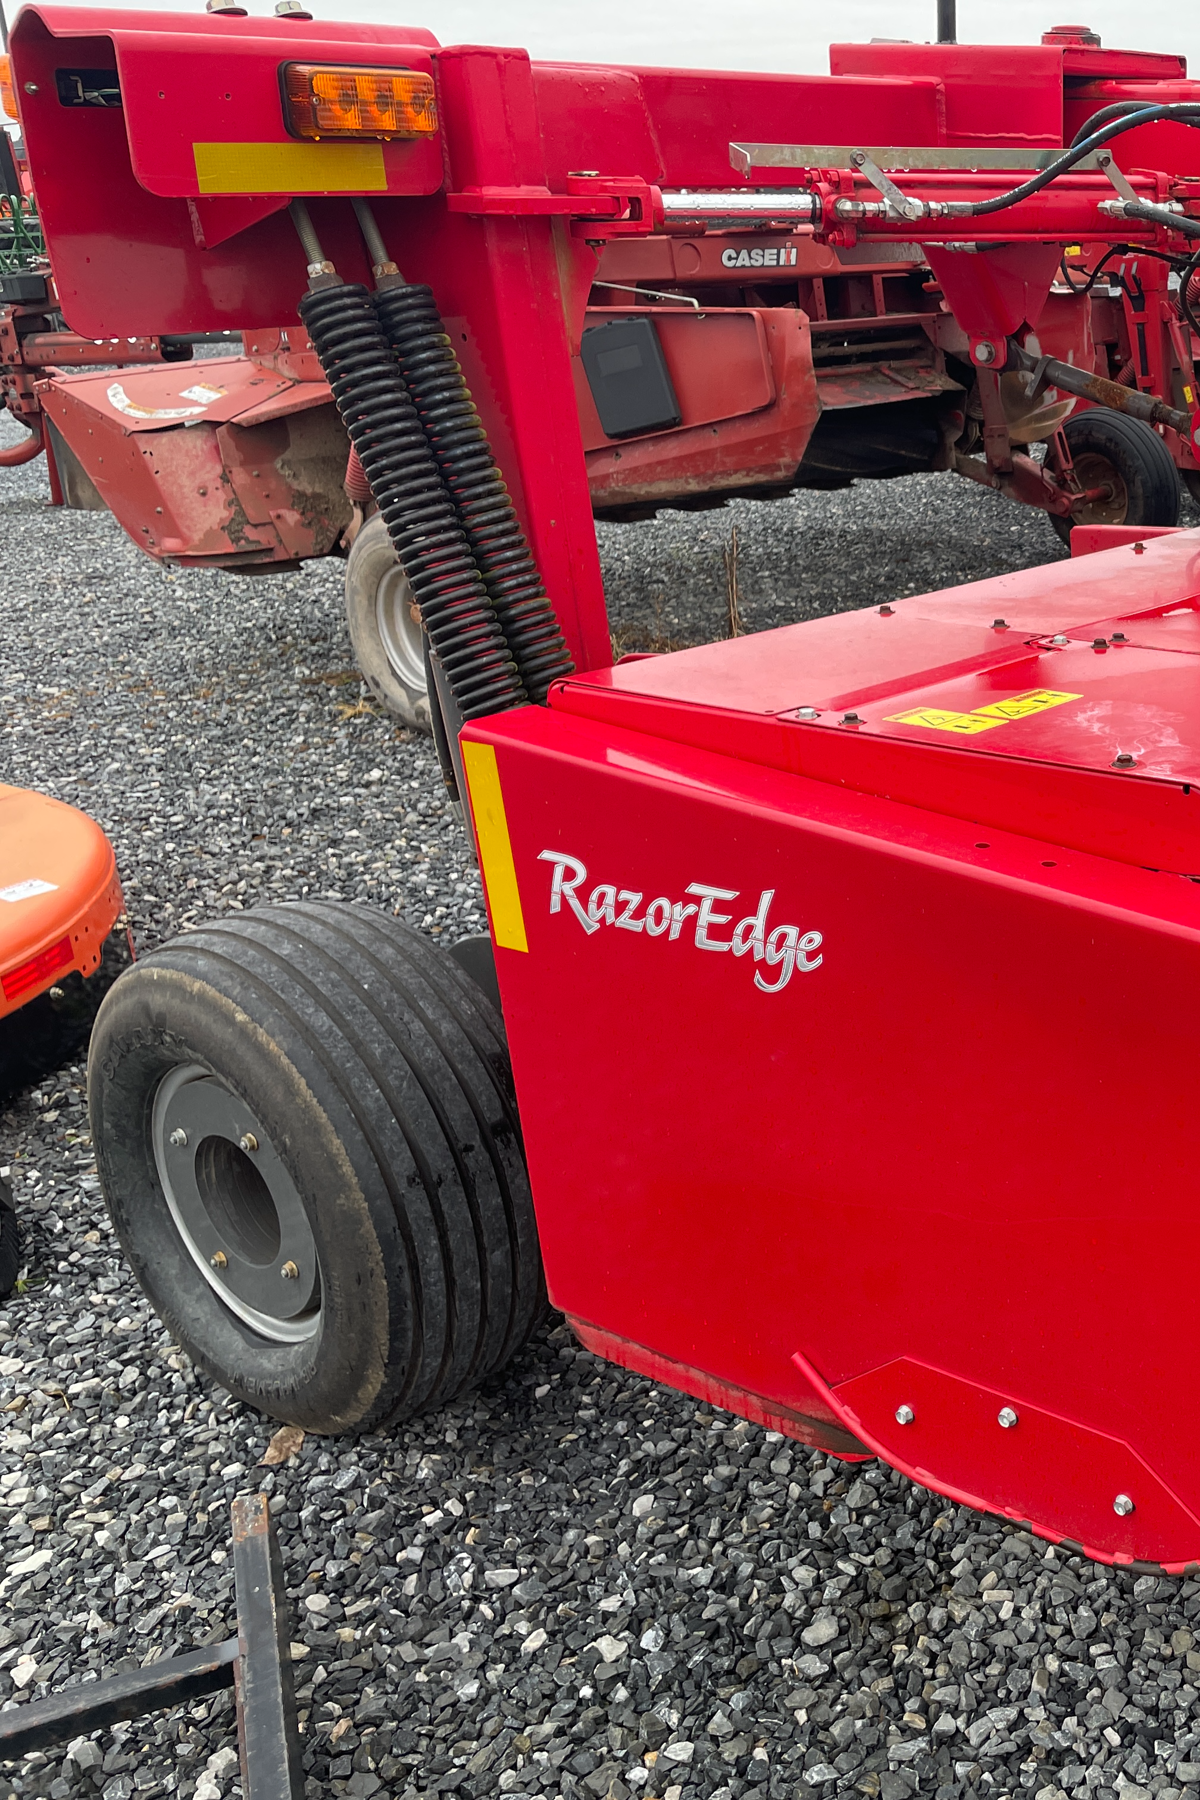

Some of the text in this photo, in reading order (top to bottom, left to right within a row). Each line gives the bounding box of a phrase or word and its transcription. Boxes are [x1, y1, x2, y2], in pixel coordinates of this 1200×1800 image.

[721, 248, 778, 268] CASE
[537, 849, 823, 993] RazorEdge
[101, 1026, 187, 1081] GALAXY
